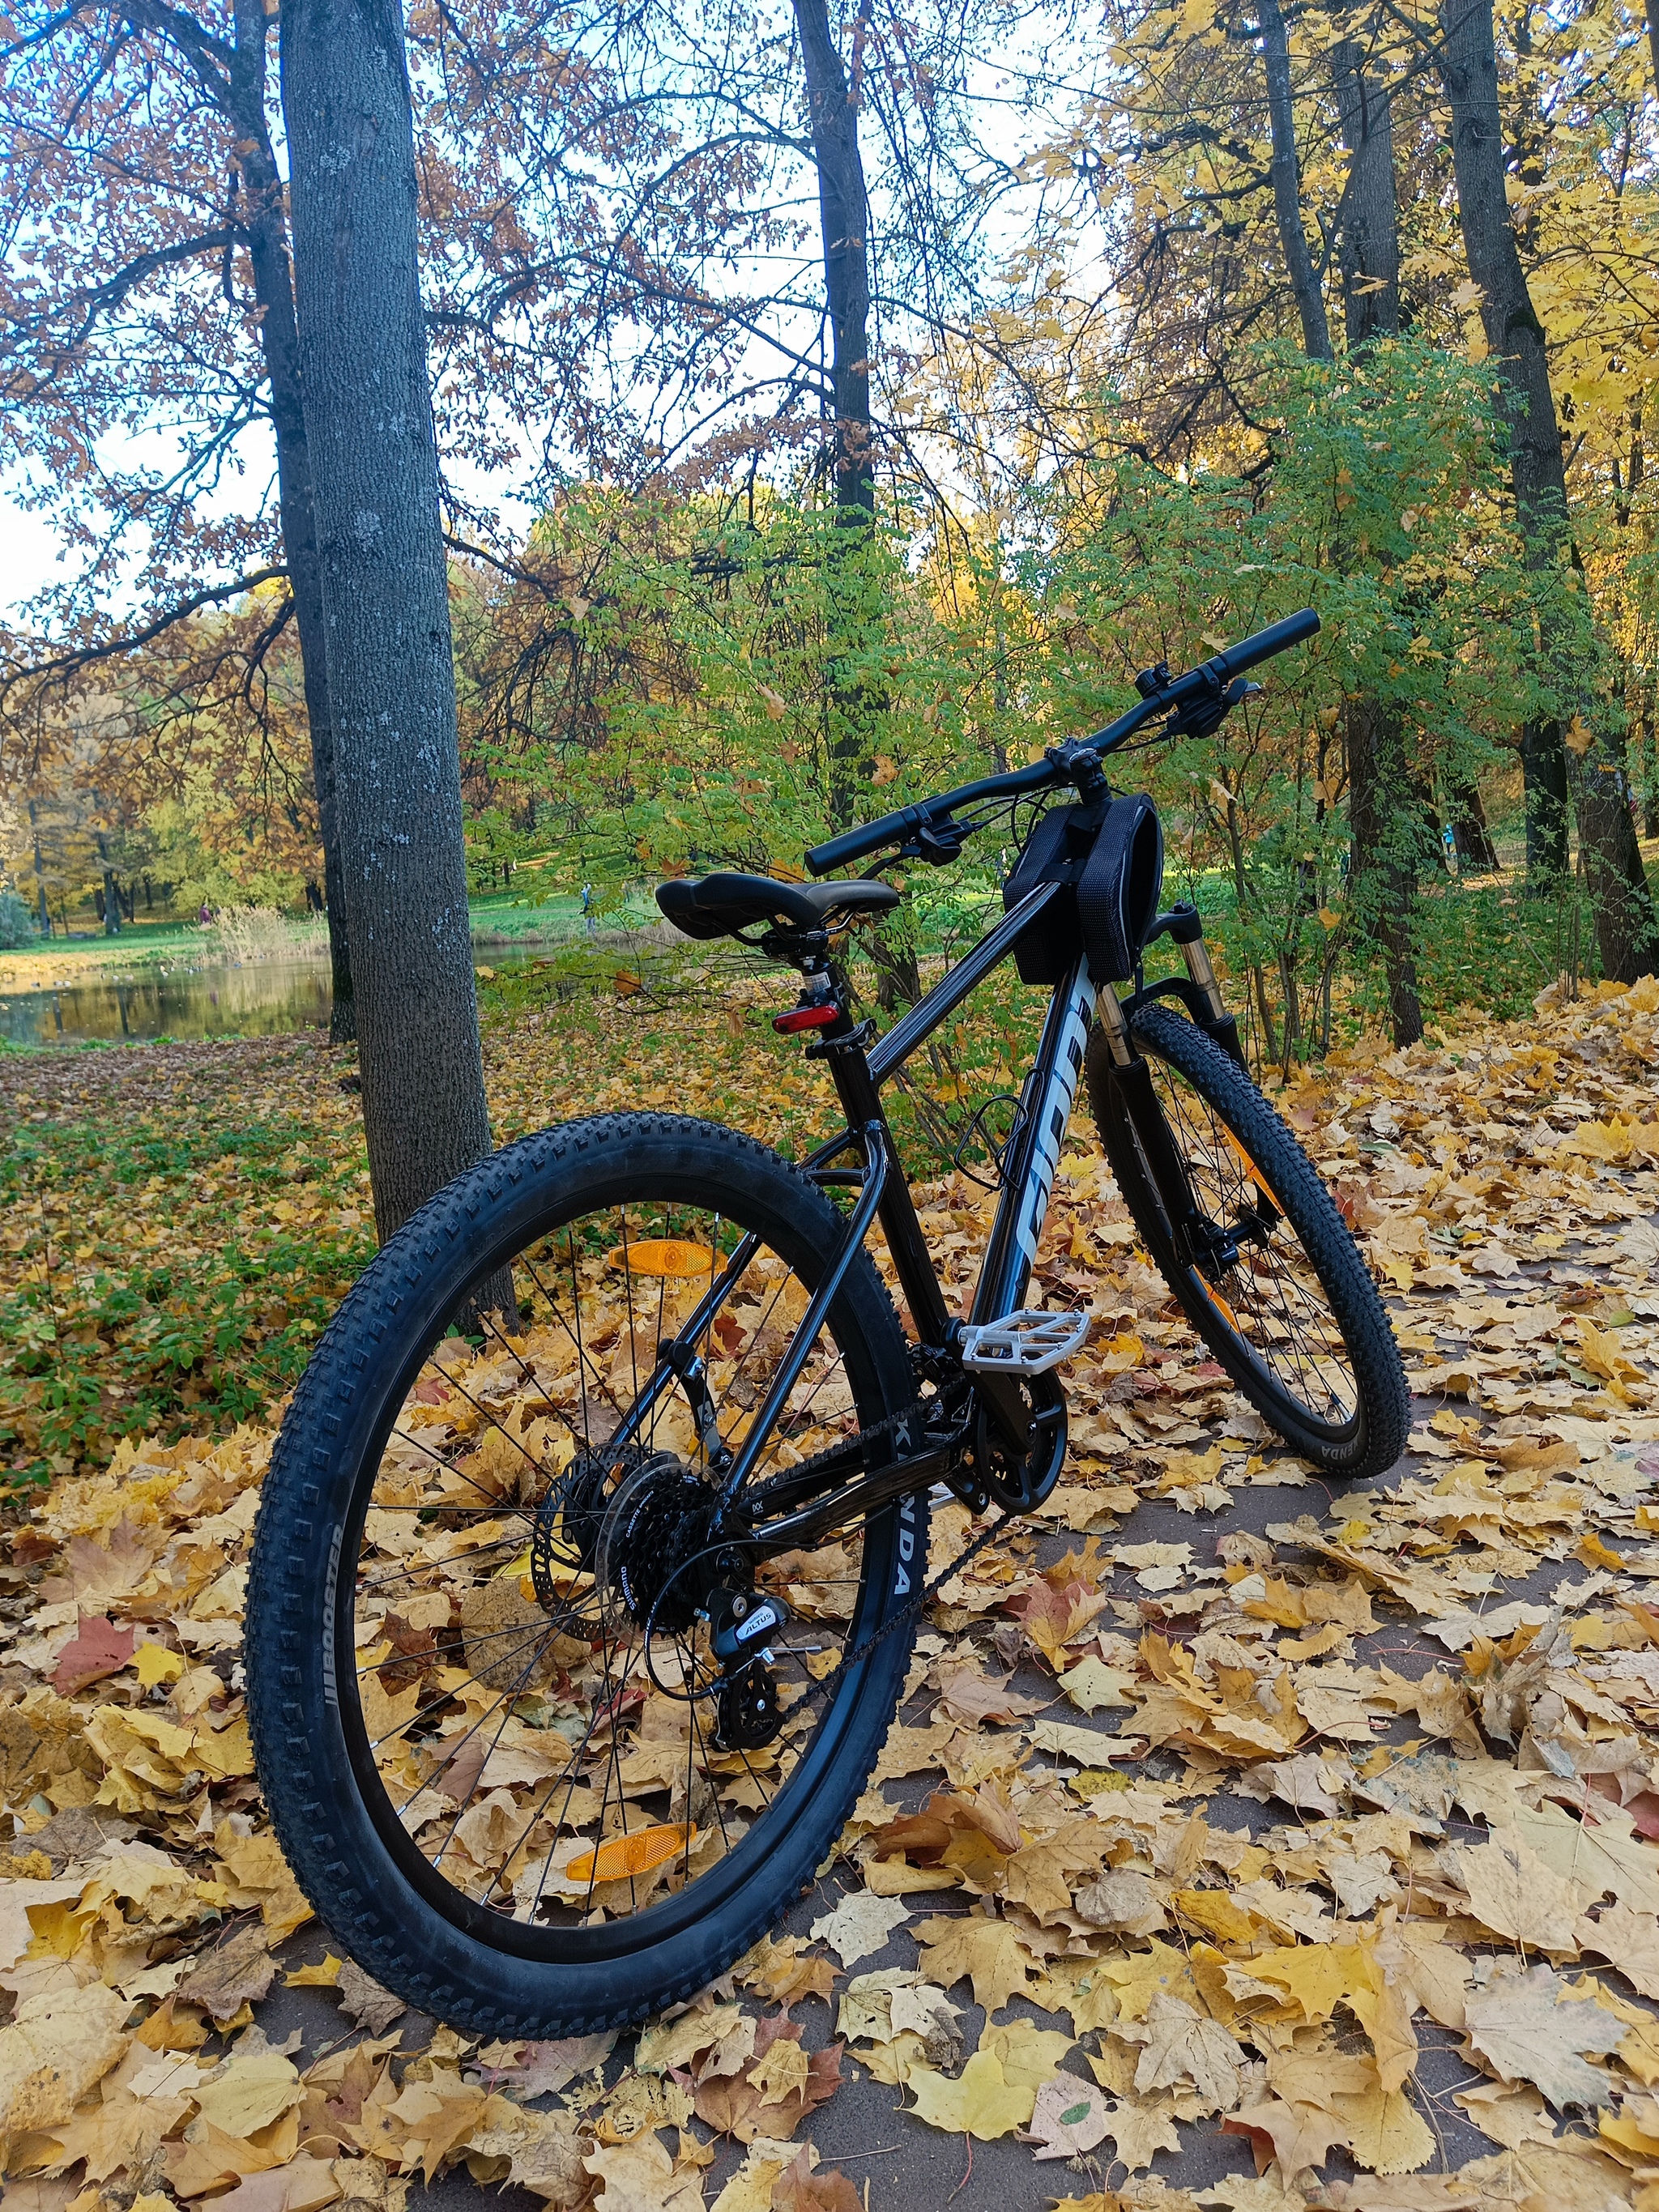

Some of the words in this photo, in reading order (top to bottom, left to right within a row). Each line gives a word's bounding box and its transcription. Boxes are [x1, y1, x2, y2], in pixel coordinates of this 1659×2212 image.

[1320, 1436, 1359, 1461] KENDA
[625, 1508, 641, 1538] CASSETTE
[893, 1418, 915, 1596] KNDA
[322, 1524, 344, 1673] BOOSTER
[621, 1566, 637, 1611] SHIMANO
[745, 1612, 772, 1636] ALTUS
